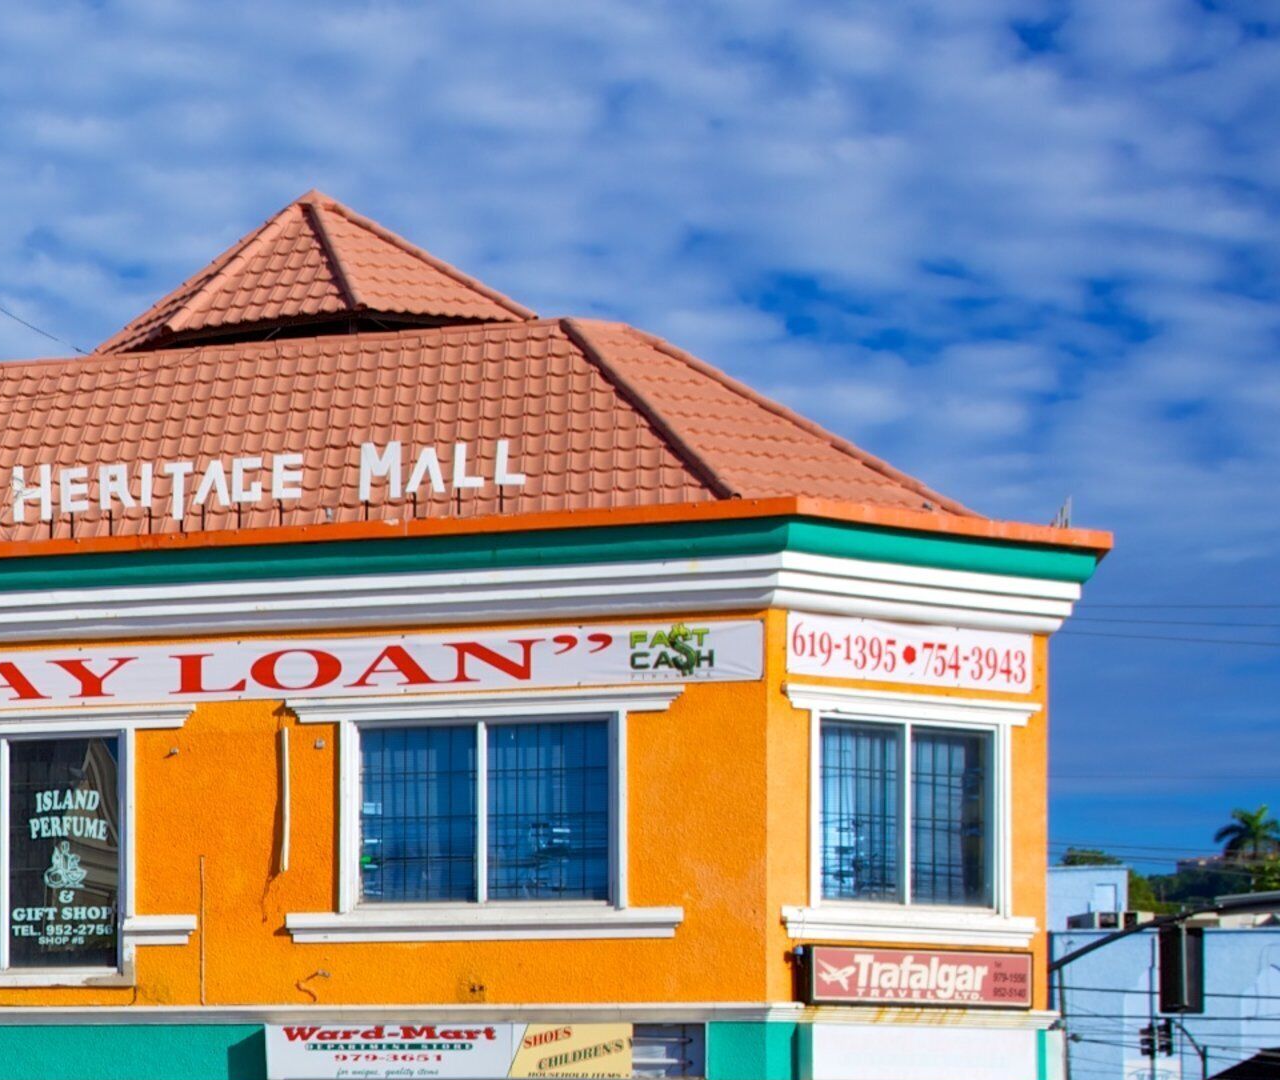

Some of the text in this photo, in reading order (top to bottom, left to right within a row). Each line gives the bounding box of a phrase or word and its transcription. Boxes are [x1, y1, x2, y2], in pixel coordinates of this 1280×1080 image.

[12, 439, 526, 522] HERITAGE MALL
[792, 621, 1027, 685] 619-1395 754-3943
[35, 789, 101, 813] ISLAND
[29, 816, 109, 840] PERFUME
[58, 890, 75, 904] &
[12, 905, 113, 921] GIFT SHOP
[12, 924, 113, 936] TEL. 952-2756
[38, 936, 69, 945] SHOP
[853, 953, 989, 999] Trafalgar
[856, 988, 984, 1001] TRAVEL LTD.
[283, 1025, 497, 1042] Ward-Mart
[523, 1026, 572, 1049] SHOES
[306, 1043, 474, 1051] DEPARTMENT STORE
[537, 1039, 625, 1070] CHILDREN'S
[335, 1053, 443, 1062] 979-3651
[336, 1066, 349, 1078] for
[384, 1066, 414, 1078] quality
